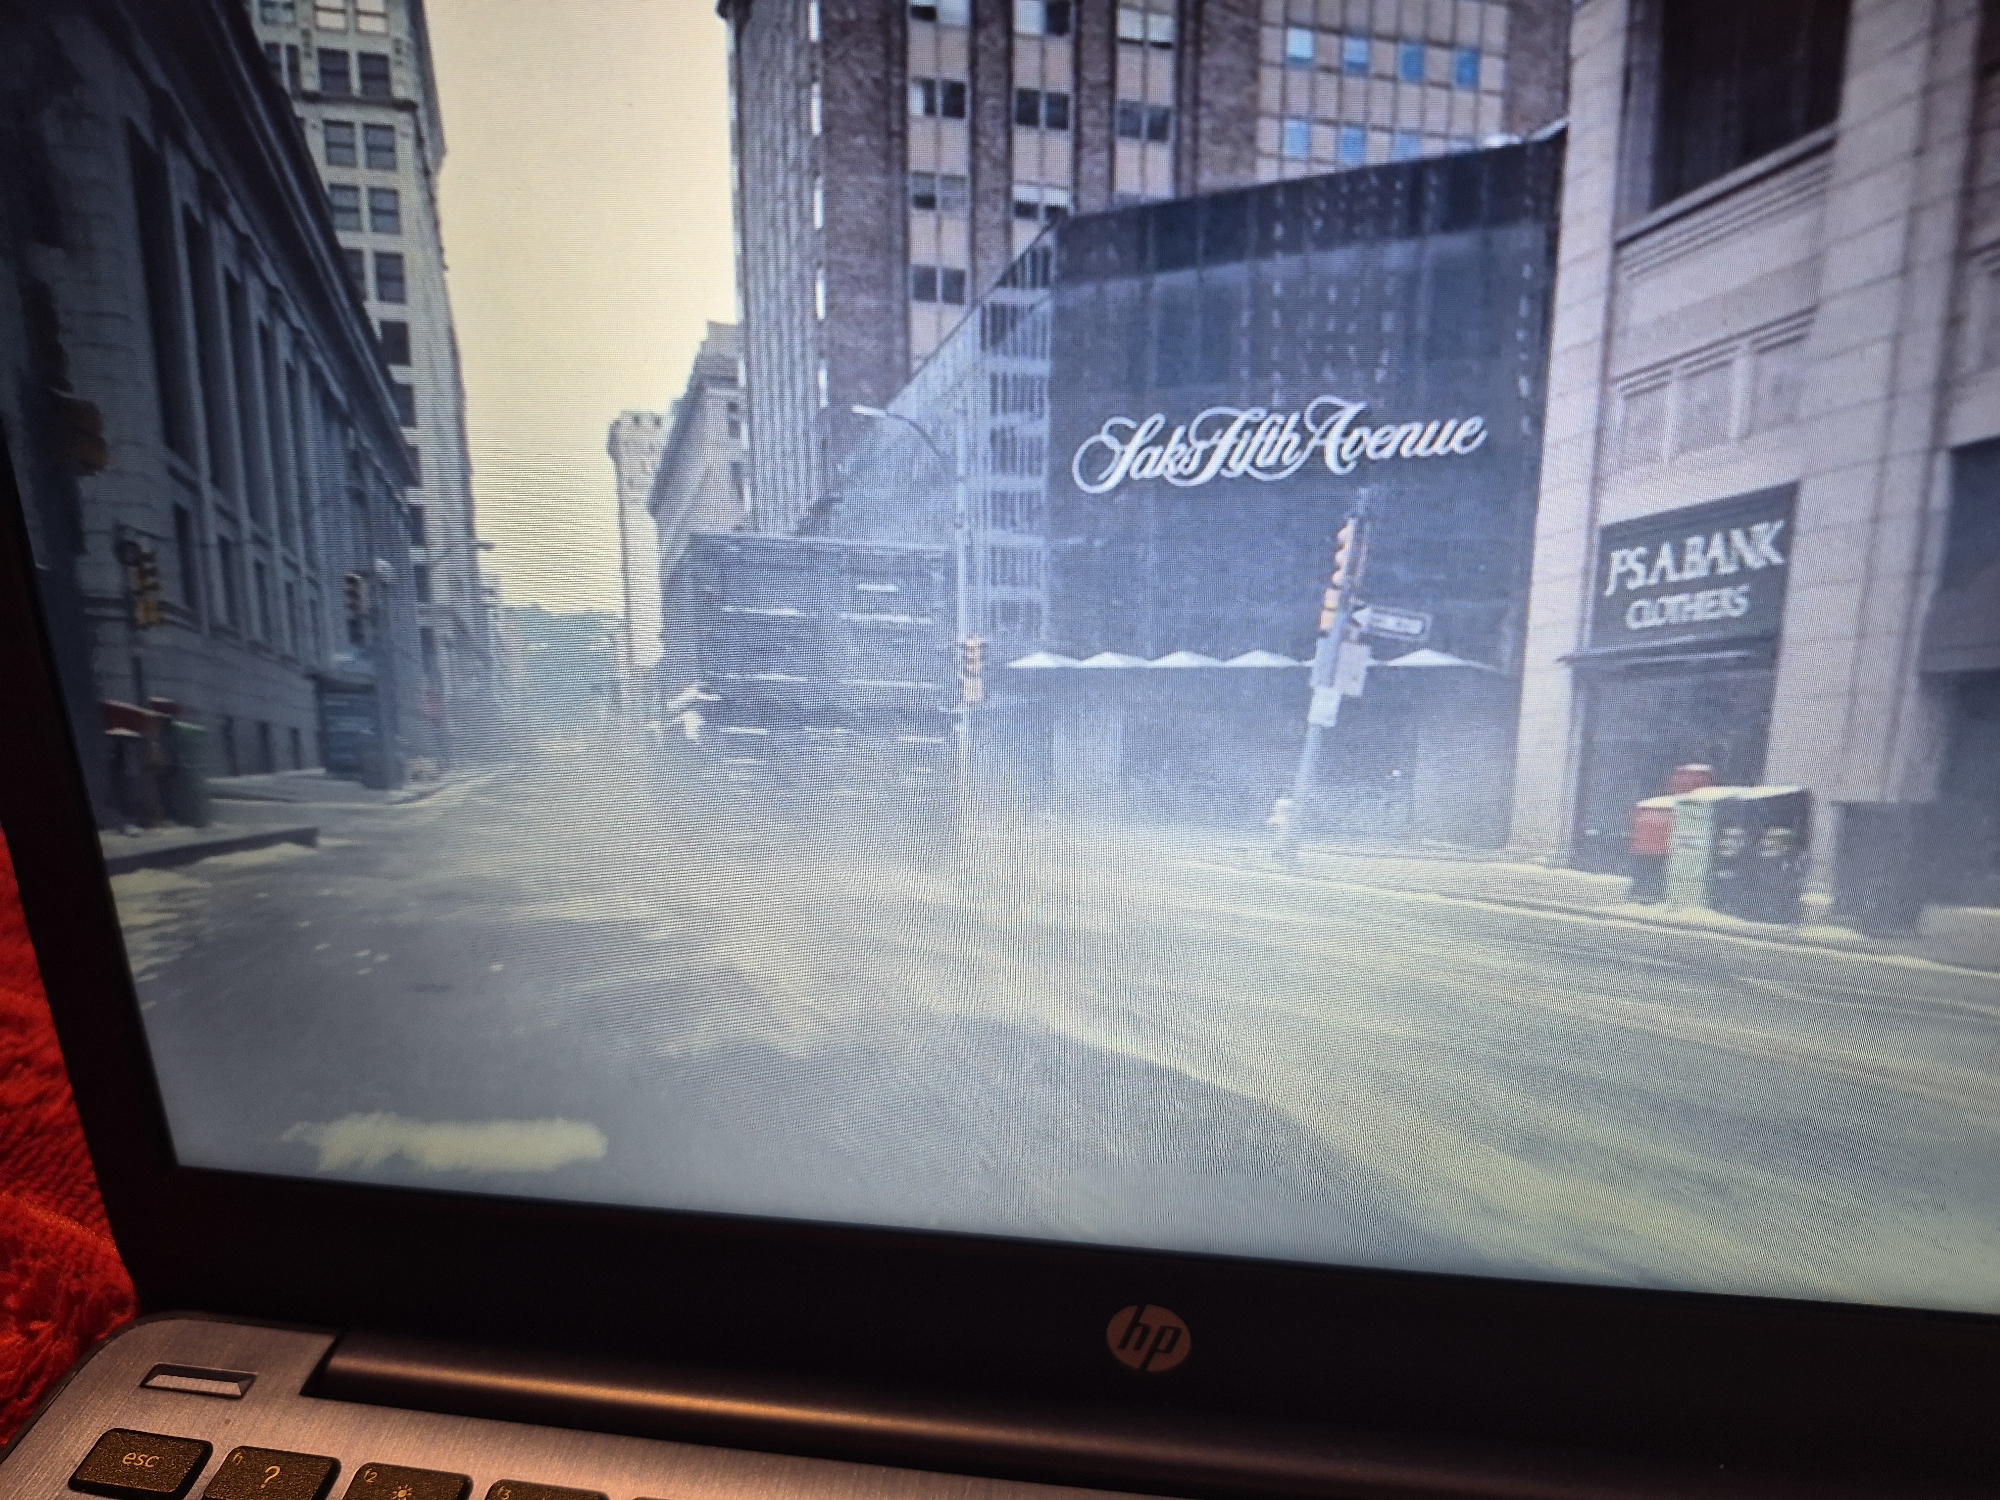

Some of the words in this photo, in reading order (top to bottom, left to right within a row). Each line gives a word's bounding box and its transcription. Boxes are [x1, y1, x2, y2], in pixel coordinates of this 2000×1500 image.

[1071, 413, 1200, 494] Saks
[1166, 406, 1303, 487] Fifth
[1299, 394, 1488, 476] Avenue
[121, 1451, 161, 1468] esc
